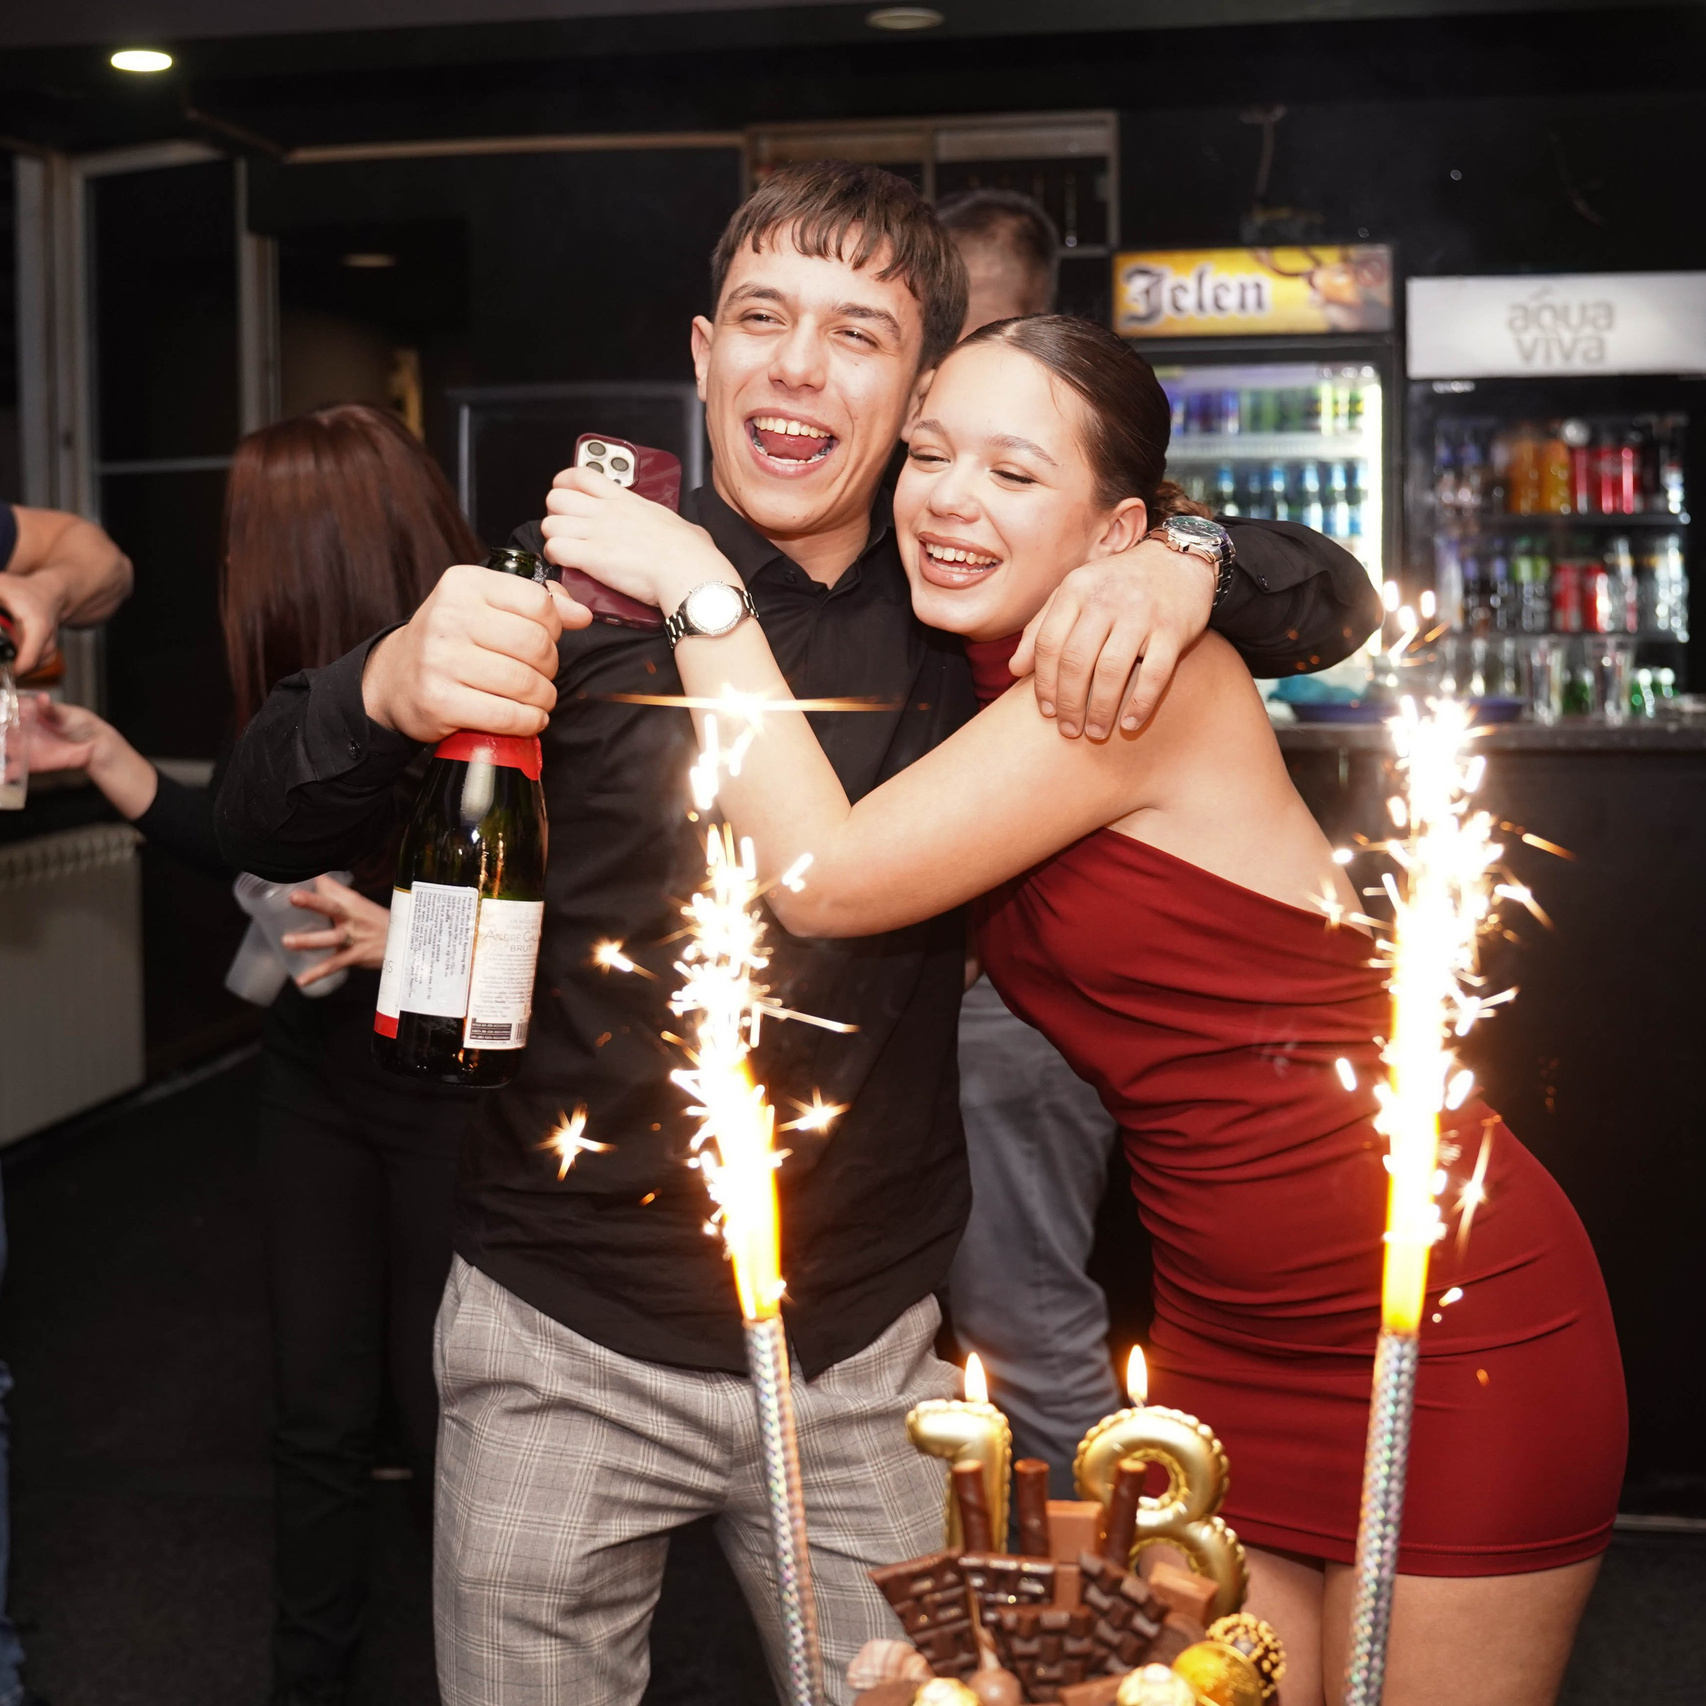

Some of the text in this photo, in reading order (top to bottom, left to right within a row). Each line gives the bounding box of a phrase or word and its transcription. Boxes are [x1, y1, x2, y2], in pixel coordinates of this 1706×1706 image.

[1124, 265, 1267, 324] Jelen
[1515, 337, 1605, 363] viva
[510, 944, 532, 953] BRUT
